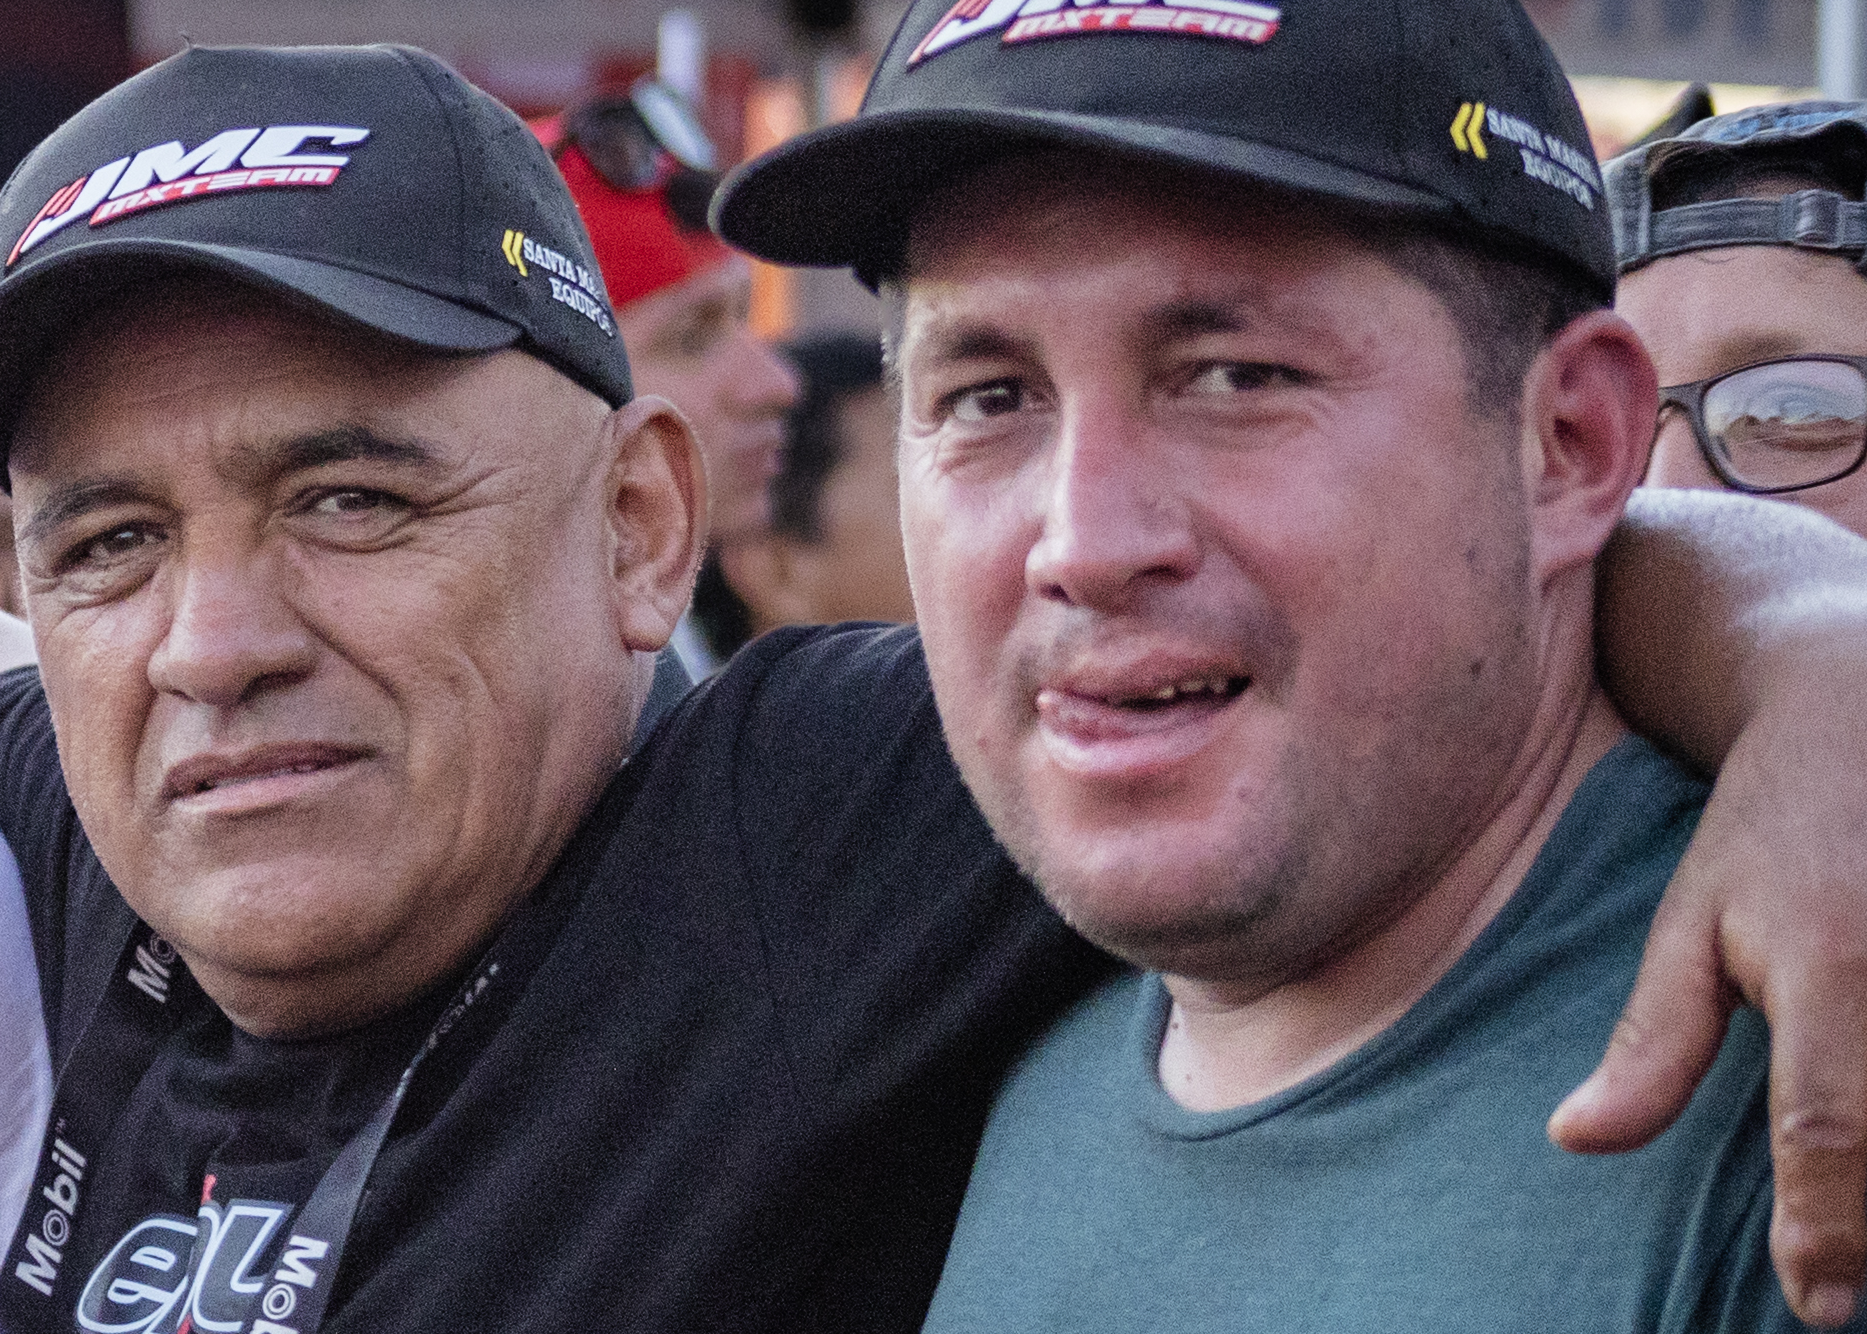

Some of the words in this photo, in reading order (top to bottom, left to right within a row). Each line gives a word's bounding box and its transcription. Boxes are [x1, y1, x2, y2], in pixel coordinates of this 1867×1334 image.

[19, 125, 370, 253] JMC
[95, 166, 332, 221] MXTEAM
[523, 237, 578, 284] SANTA
[15, 1137, 88, 1298] Mobil
